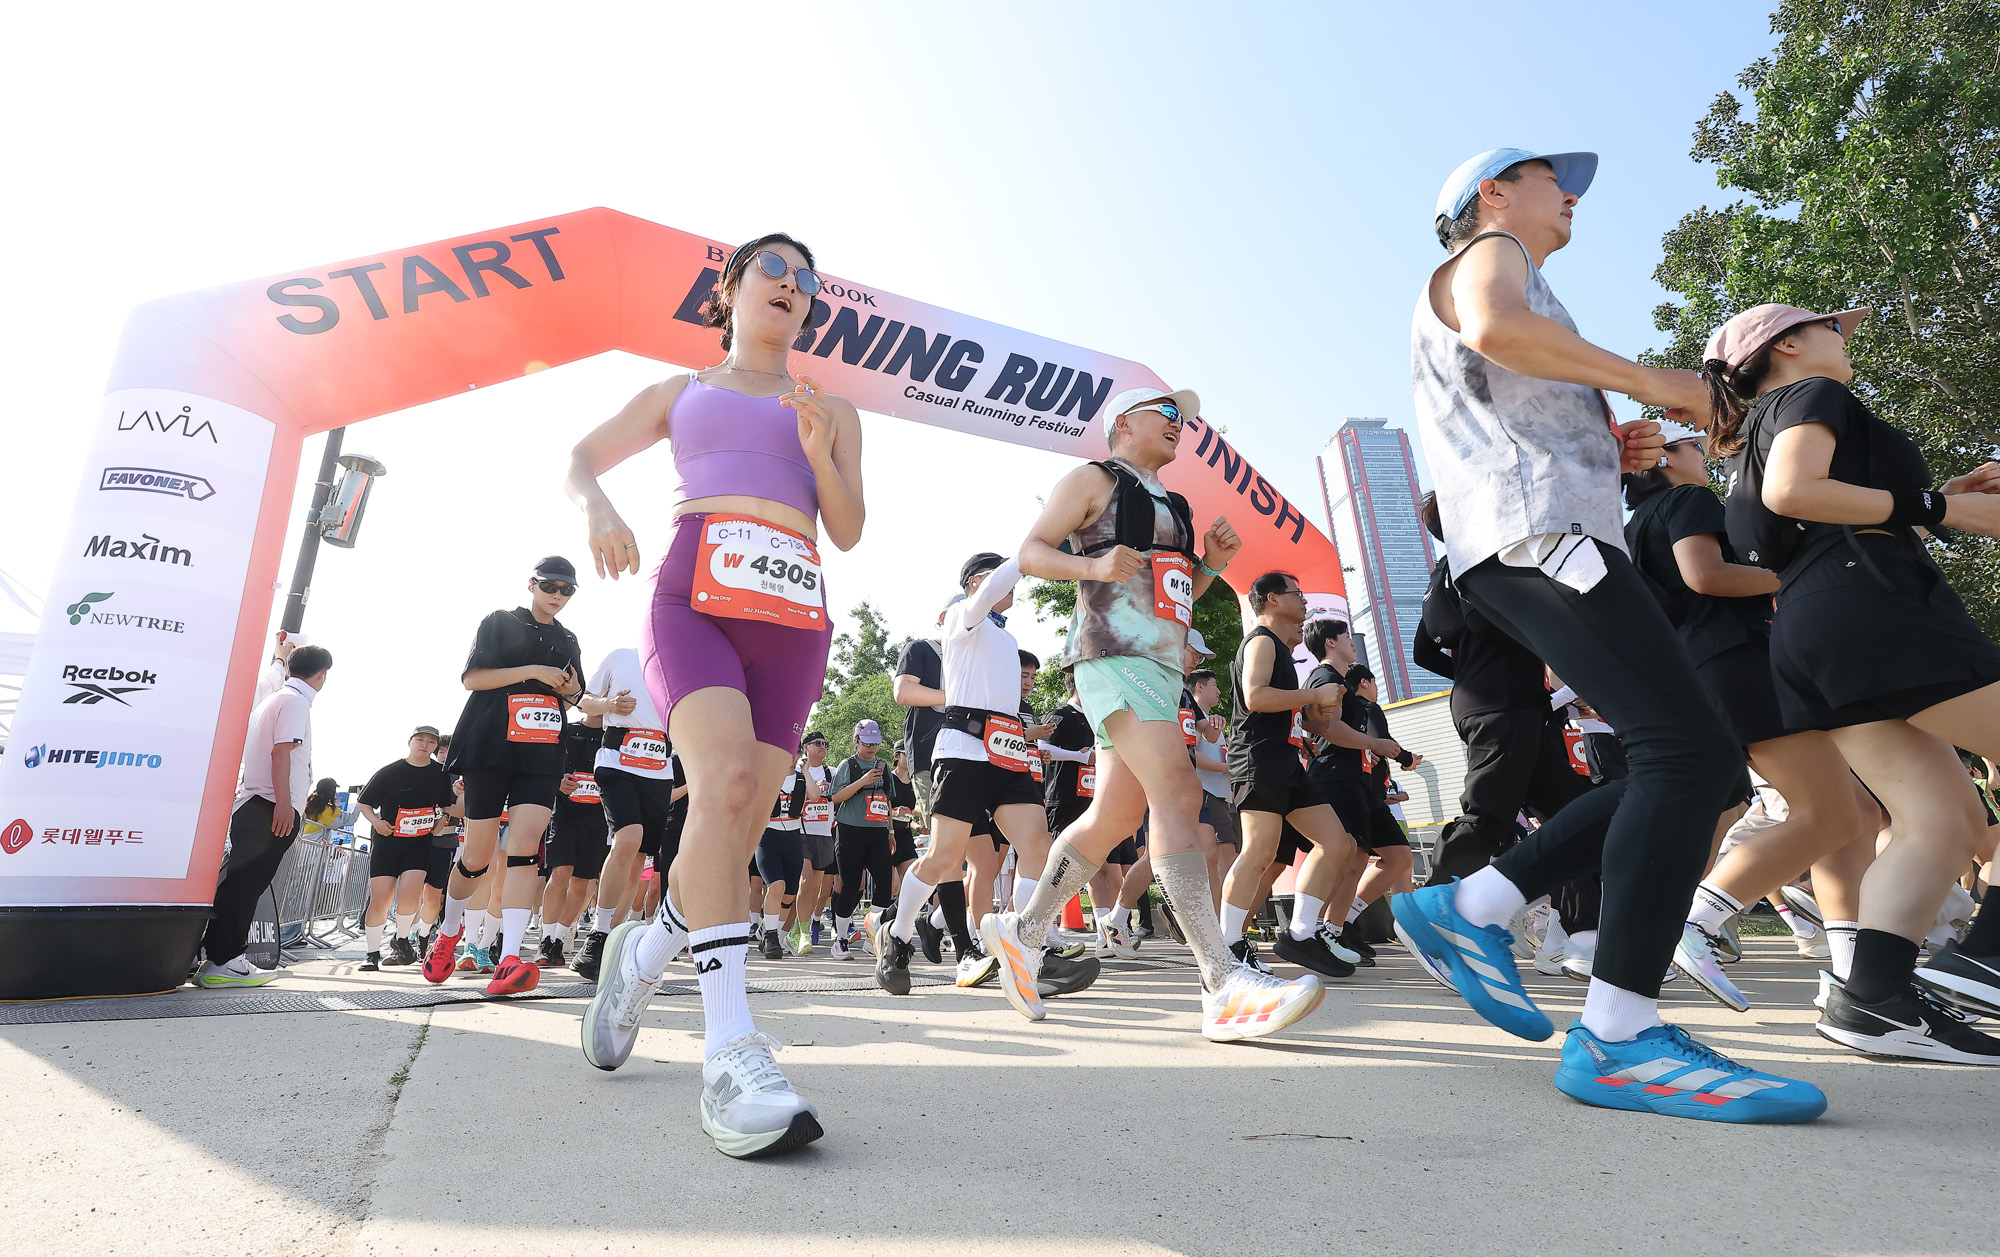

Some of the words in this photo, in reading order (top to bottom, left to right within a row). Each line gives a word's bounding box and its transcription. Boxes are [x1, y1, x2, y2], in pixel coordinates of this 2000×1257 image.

[266, 227, 566, 335] START
[672, 266, 985, 393] BRNING
[984, 352, 1115, 422] RUN
[903, 385, 960, 409] Casual
[961, 399, 1026, 427] Running
[1027, 414, 1086, 438] Festival
[107, 472, 198, 499] FAVONEX
[718, 528, 751, 541] C-11
[83, 533, 192, 567] Maxim
[723, 553, 745, 568] W
[750, 555, 817, 591] 4305
[1170, 578, 1179, 590] M
[1181, 580, 1193, 598] 18
[90, 612, 185, 634] NEWTREE
[62, 664, 157, 685] Reebok
[1121, 666, 1168, 708] SALOMON
[533, 711, 561, 723] 3729
[631, 742, 641, 750] M
[643, 742, 665, 755] 1504
[993, 737, 1002, 746] M
[1004, 737, 1027, 753] 1609
[411, 818, 434, 826] 3859
[41, 827, 144, 846] 롯데웰푸드
[1051, 857, 1070, 888] SALOMON
[1154, 873, 1177, 913] SALOMON
[261, 921, 276, 943] LINE
